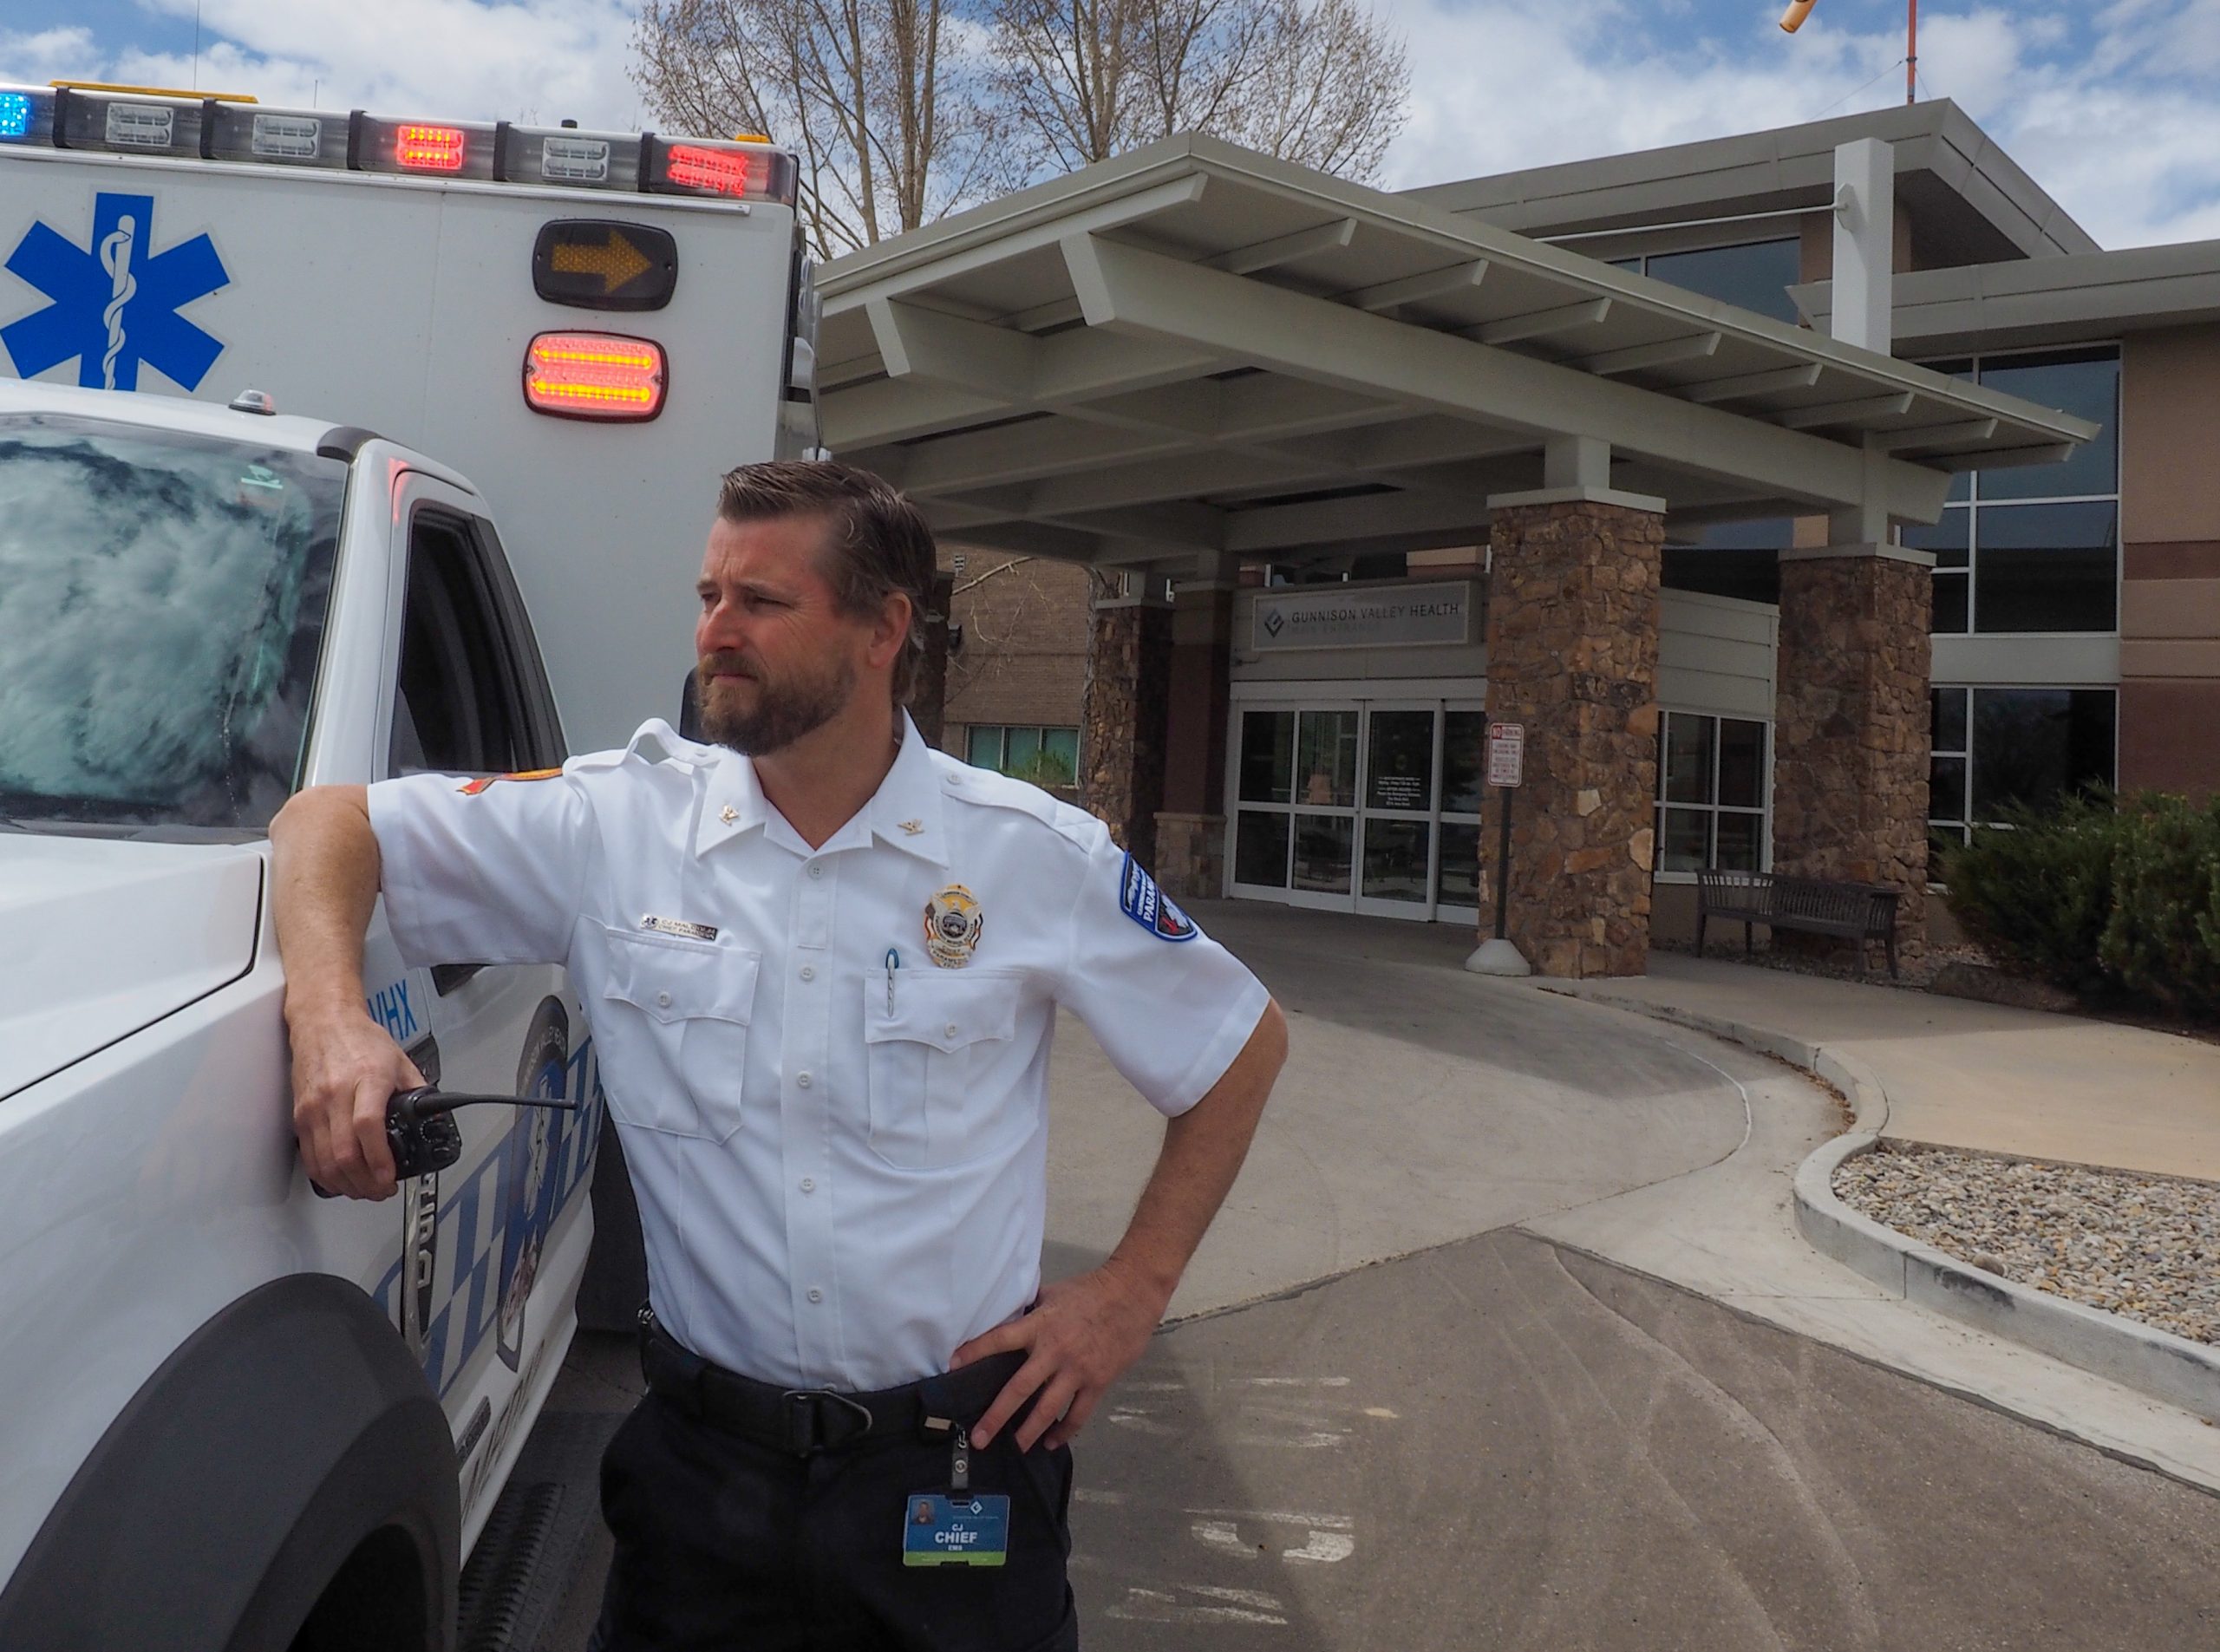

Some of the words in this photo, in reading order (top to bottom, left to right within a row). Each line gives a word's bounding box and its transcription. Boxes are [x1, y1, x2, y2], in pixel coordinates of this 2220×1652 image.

[1292, 609, 1355, 623] GUNNISON
[1361, 605, 1405, 619] VALLEY
[1409, 603, 1459, 617] HEALTH
[951, 1523, 964, 1531] CJ
[934, 1531, 978, 1544] CHIEF
